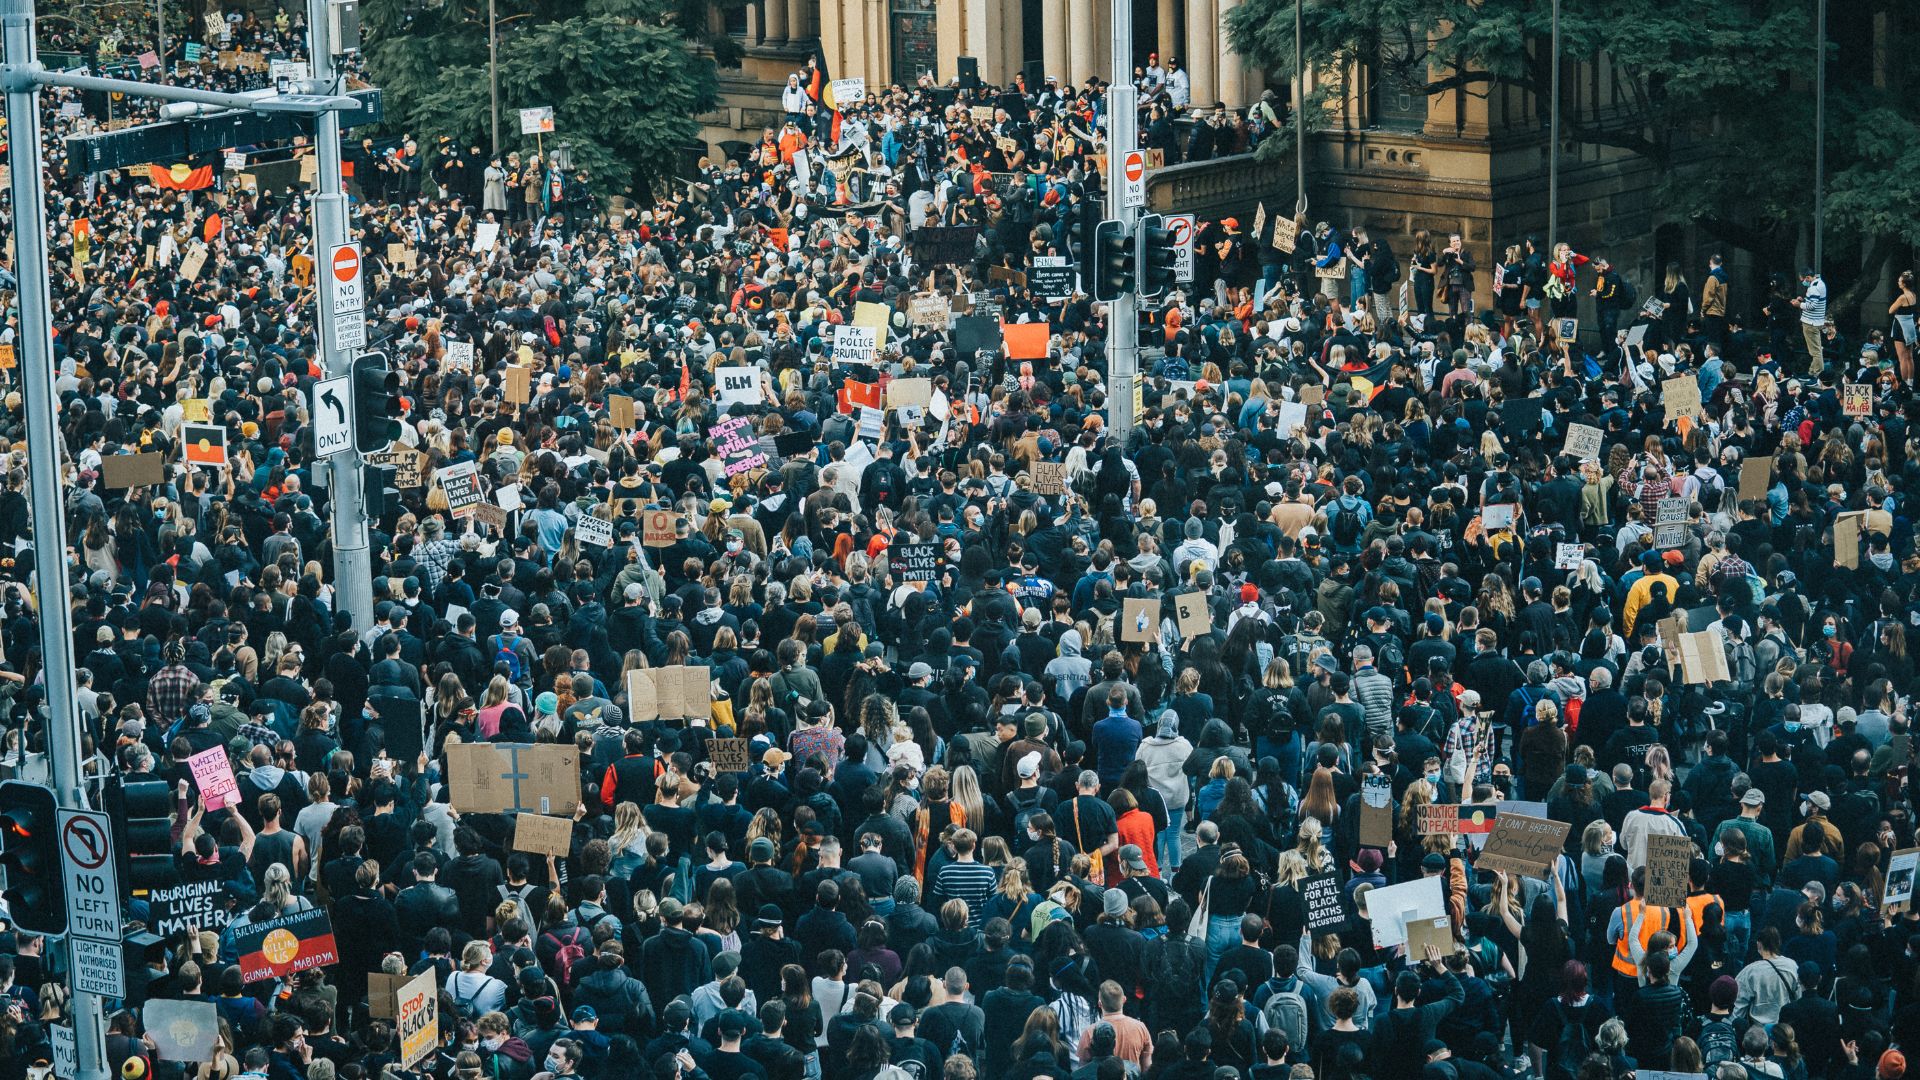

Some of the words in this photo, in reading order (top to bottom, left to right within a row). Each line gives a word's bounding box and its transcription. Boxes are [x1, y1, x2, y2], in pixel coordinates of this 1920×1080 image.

[1129, 184, 1140, 194] NO
[1126, 194, 1144, 204] ENTRY
[1174, 261, 1189, 269] GHT
[340, 284, 355, 297] NO
[335, 297, 361, 311] ENTRY
[336, 315, 350, 326] LIGHT
[350, 314, 361, 322] RAIL
[337, 322, 362, 333] AUTHORISED
[339, 330, 361, 341] VEHICLES
[850, 327, 861, 337] FK
[338, 339, 362, 350] EXCEPTED
[840, 337, 874, 348] POLICE
[725, 375, 753, 391] BLM
[1845, 385, 1870, 397] BLACK
[1676, 407, 1692, 417] BLM
[708, 416, 751, 440] RACISM
[319, 430, 348, 449] ONLY
[723, 430, 739, 443] IS
[717, 434, 759, 460] SMALL
[1036, 463, 1063, 477] BLAK
[445, 476, 471, 490] BLACK
[1035, 473, 1065, 485] LIVES
[448, 486, 470, 499] LIVES
[450, 493, 481, 508] MATTER
[579, 515, 611, 529] PROTECT
[901, 545, 935, 558] BLACK
[909, 557, 936, 569] LIVES
[902, 569, 937, 581] MATTER
[1179, 605, 1191, 620] B
[707, 739, 746, 753] BLACK
[191, 750, 223, 769] WHITE
[712, 752, 743, 763] LIVES
[194, 760, 231, 779] SILENCE
[715, 762, 747, 771] MATTER
[202, 778, 237, 800] DEATH
[1427, 804, 1458, 819] JUSTICE
[1429, 819, 1457, 833] PEACE
[1490, 829, 1509, 852] 8
[1649, 859, 1687, 872] CHILDREN
[76, 873, 105, 895] NO
[1305, 877, 1336, 892] JUSTICE
[1304, 889, 1322, 901] FOR
[1323, 886, 1341, 898] ALL
[75, 898, 110, 914] LEFT
[170, 896, 214, 915] LIVES
[1309, 895, 1338, 910] BLACK
[1308, 905, 1342, 921] DEATHS
[76, 915, 114, 933] TURN
[158, 908, 228, 937] MATTER
[1308, 920, 1316, 929] IN
[1317, 914, 1346, 927] CUSTODY
[76, 942, 99, 955] LIGHT
[99, 945, 117, 958] RAIL
[78, 954, 118, 971] AUTHORISED
[273, 952, 289, 964] US
[293, 951, 334, 970] MABIDYA
[80, 966, 117, 982] VEHICLES
[243, 966, 275, 984] GUNHA
[80, 979, 118, 995] EXCEPTED
[402, 992, 424, 1020] STOP
[403, 1006, 426, 1041] BLACK
